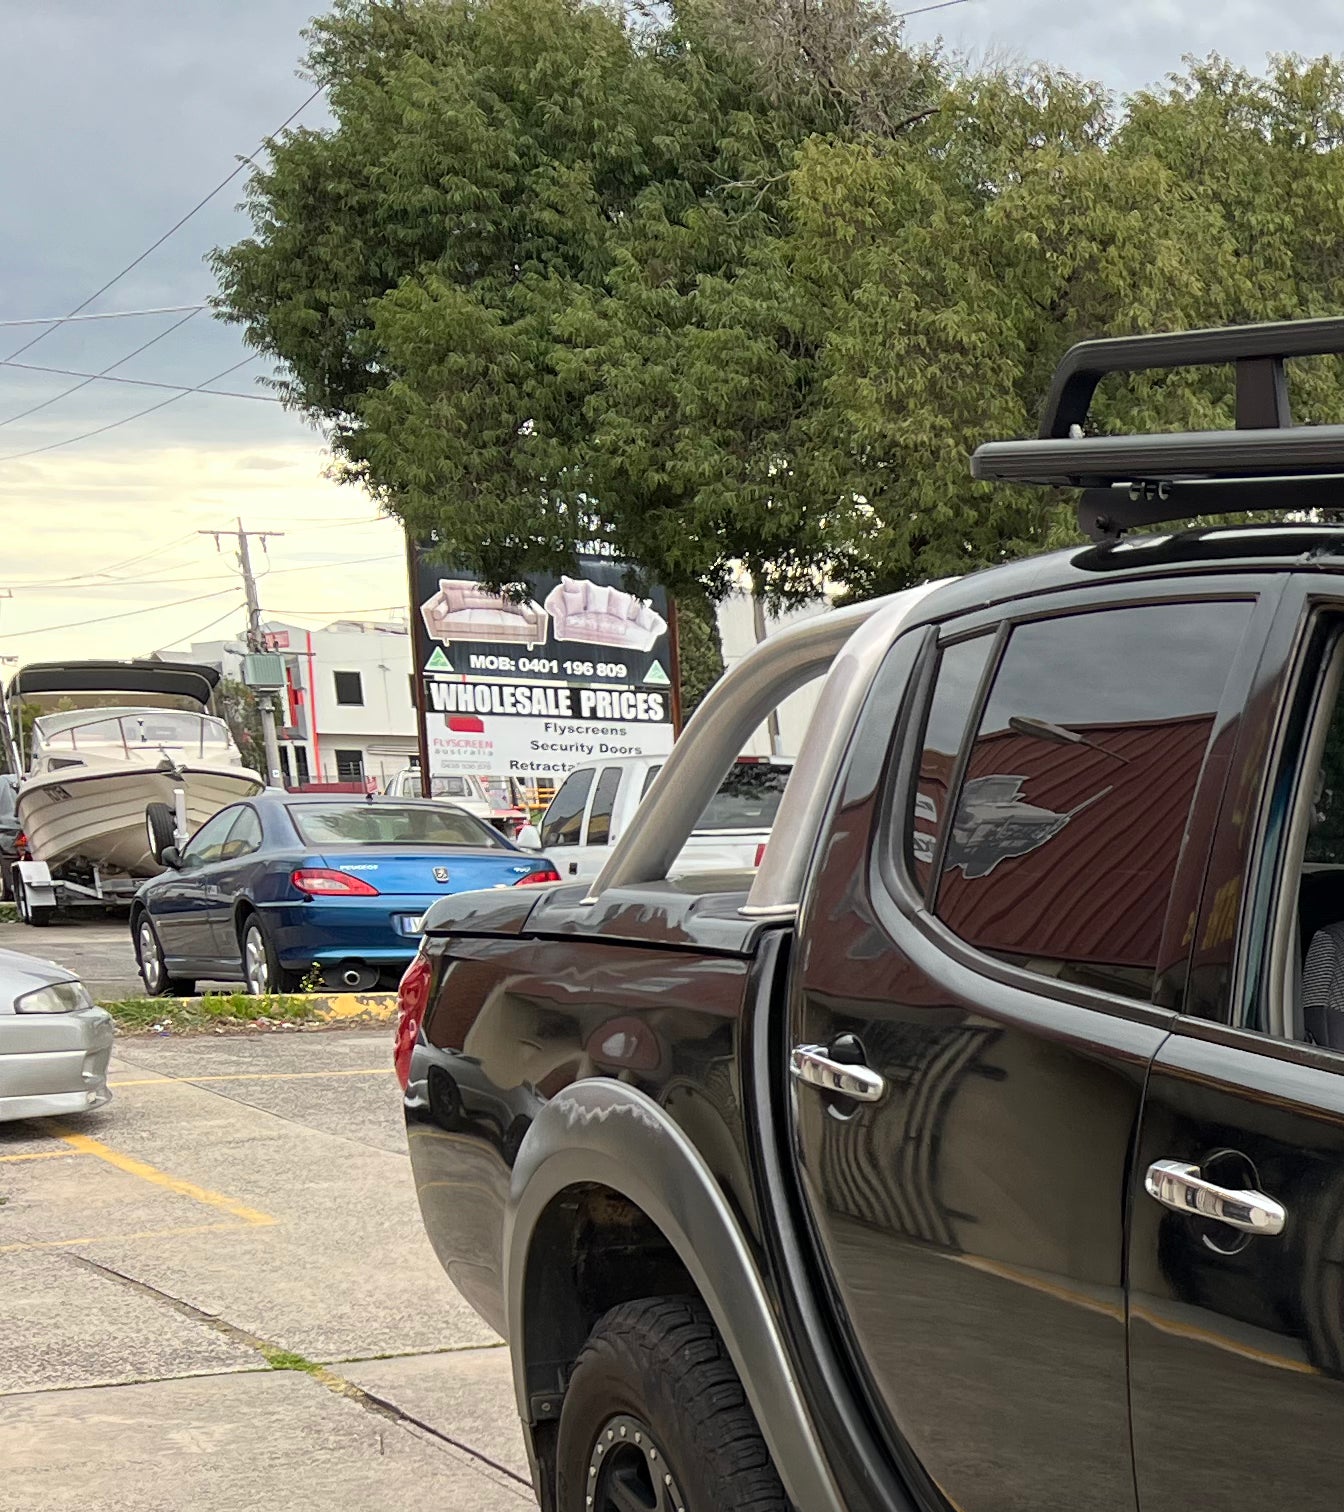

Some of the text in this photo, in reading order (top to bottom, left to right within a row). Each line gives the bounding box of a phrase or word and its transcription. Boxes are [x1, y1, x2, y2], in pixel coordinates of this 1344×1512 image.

[469, 655, 628, 678] MOB: 0401 196 809
[429, 682, 666, 721] WHOLESALE PRICES
[544, 722, 628, 737] Flyscreens
[433, 737, 494, 749] FLYSCREEN
[530, 739, 643, 755] Security Doors
